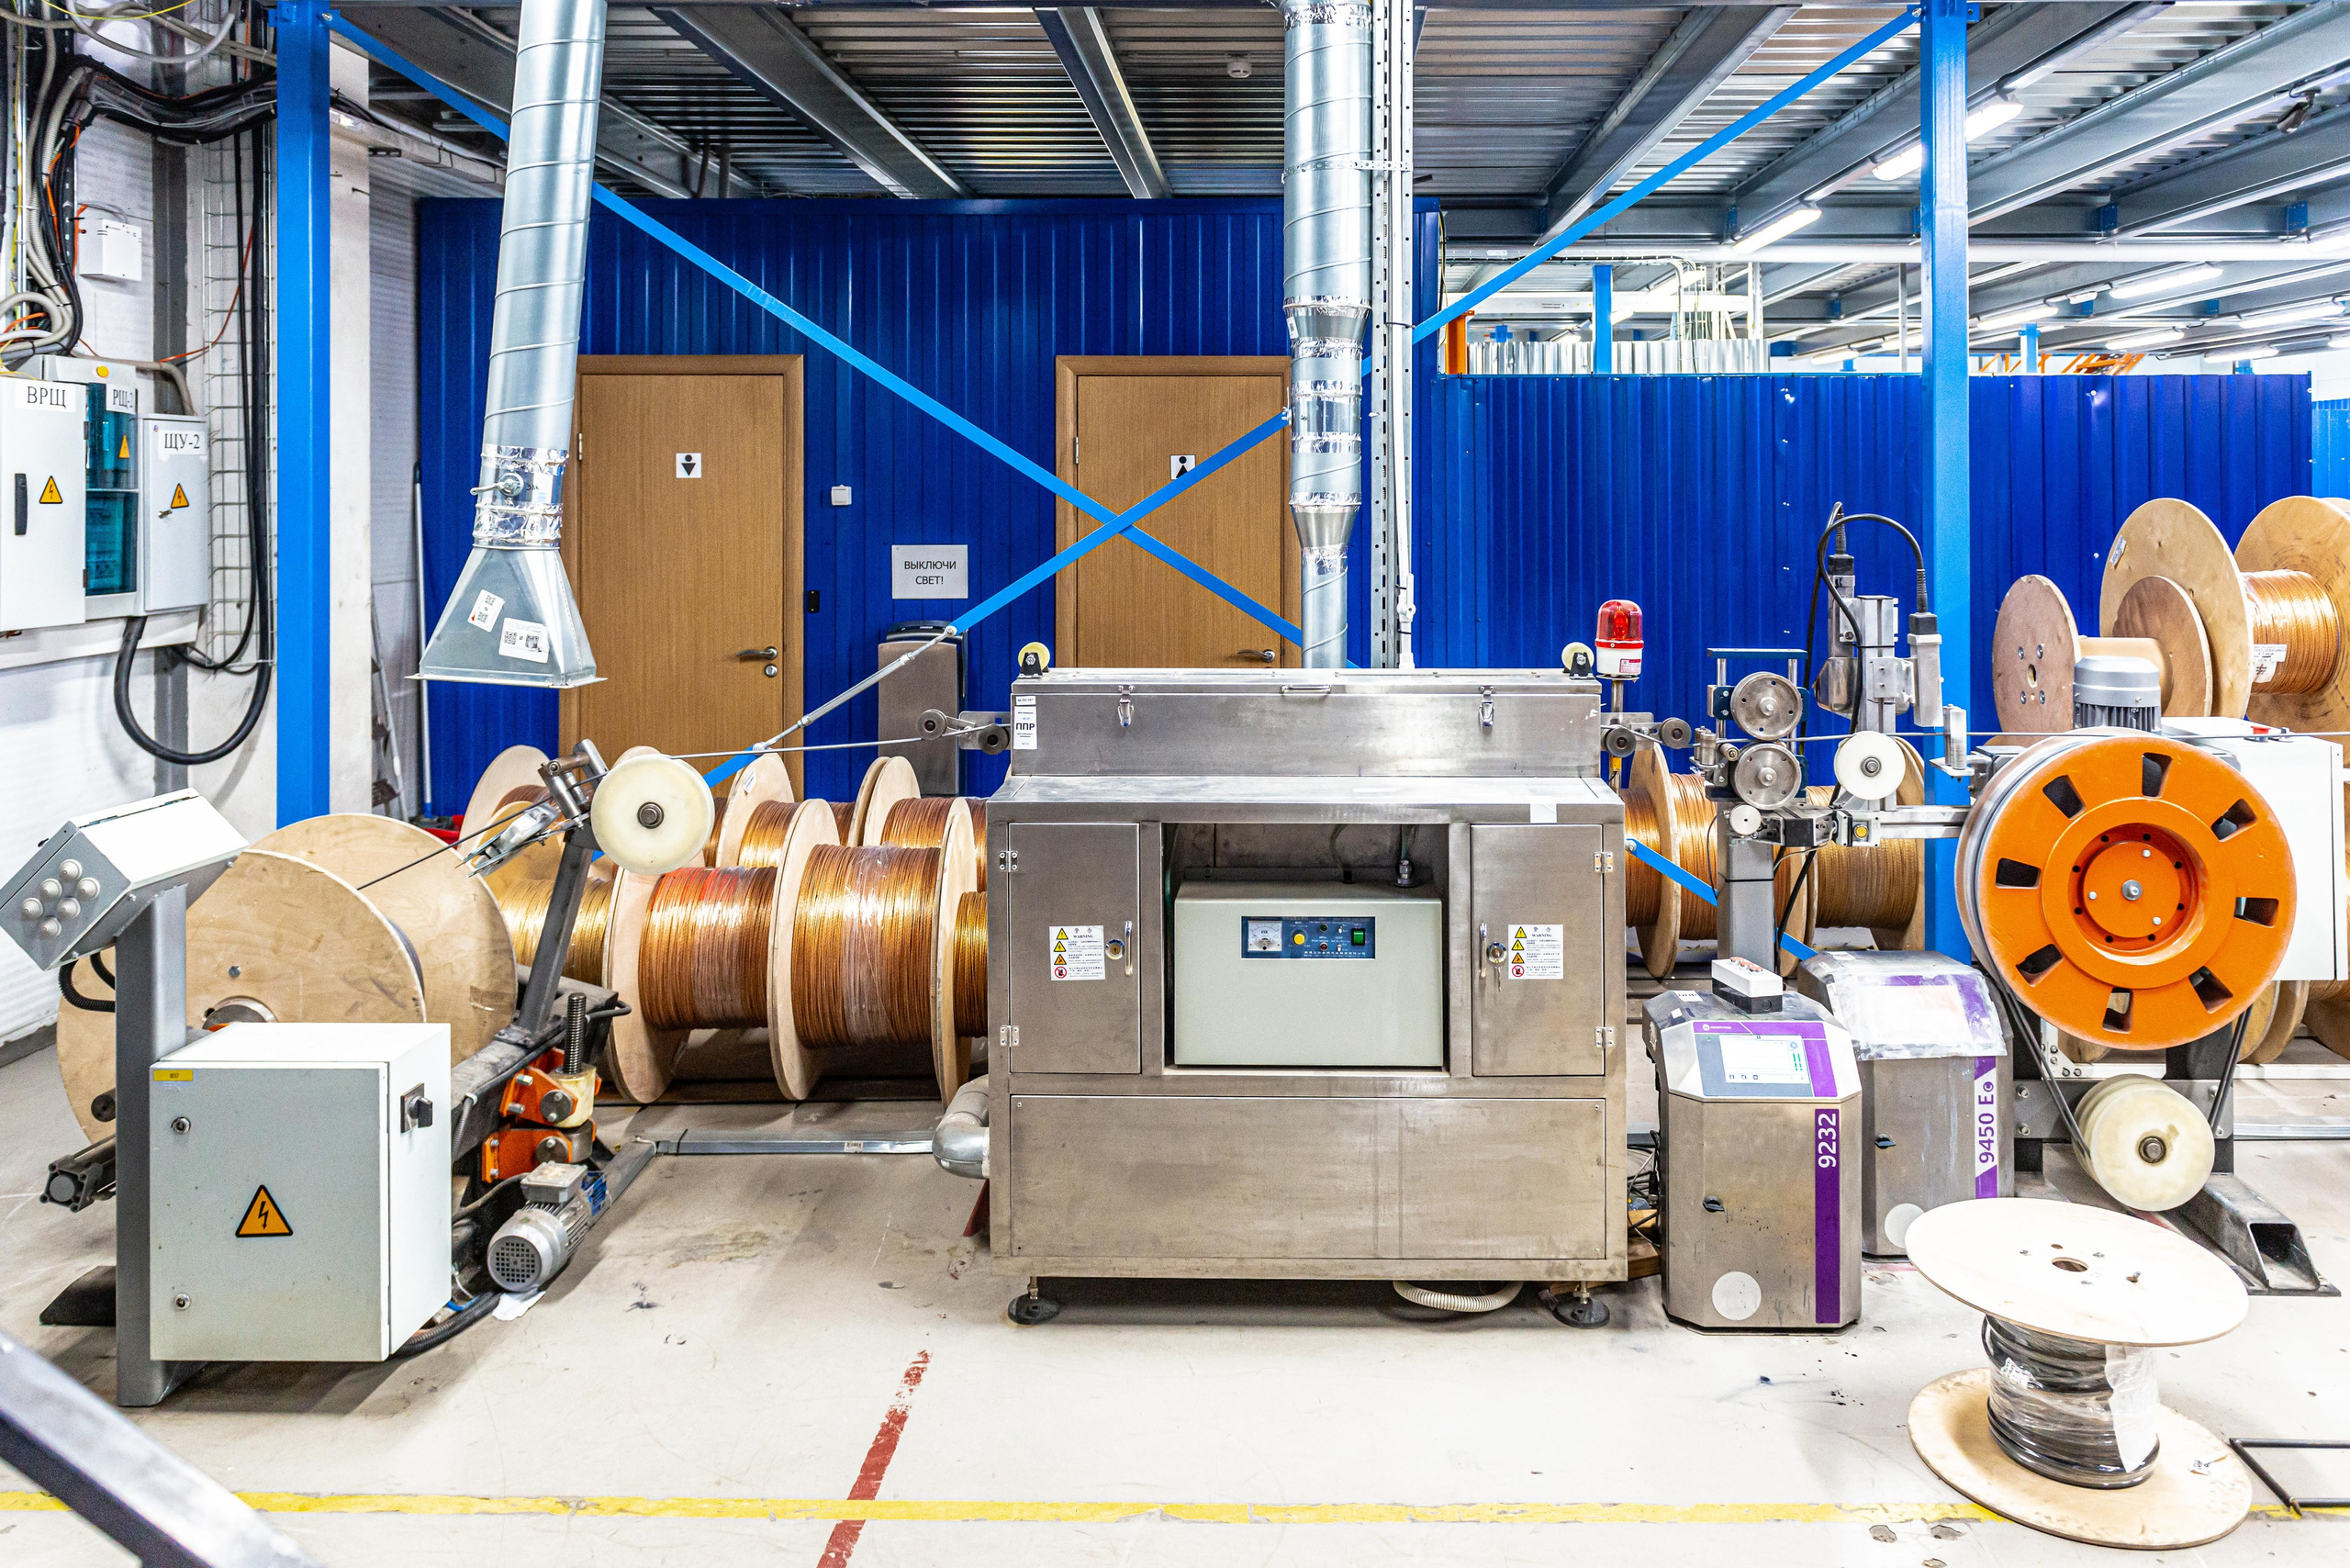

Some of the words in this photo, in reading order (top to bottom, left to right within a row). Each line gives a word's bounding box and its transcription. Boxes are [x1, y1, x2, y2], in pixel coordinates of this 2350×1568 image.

[27, 386, 67, 409] ВРЩ
[164, 433, 200, 451] ЩУ-2
[904, 560, 957, 570] ВЫКЛЮЧИ
[915, 576, 944, 585] СВЕТ!
[1015, 722, 1035, 731] ППР
[1818, 1113, 1837, 1169] 9232
[1978, 1113, 1995, 1164] 9450
